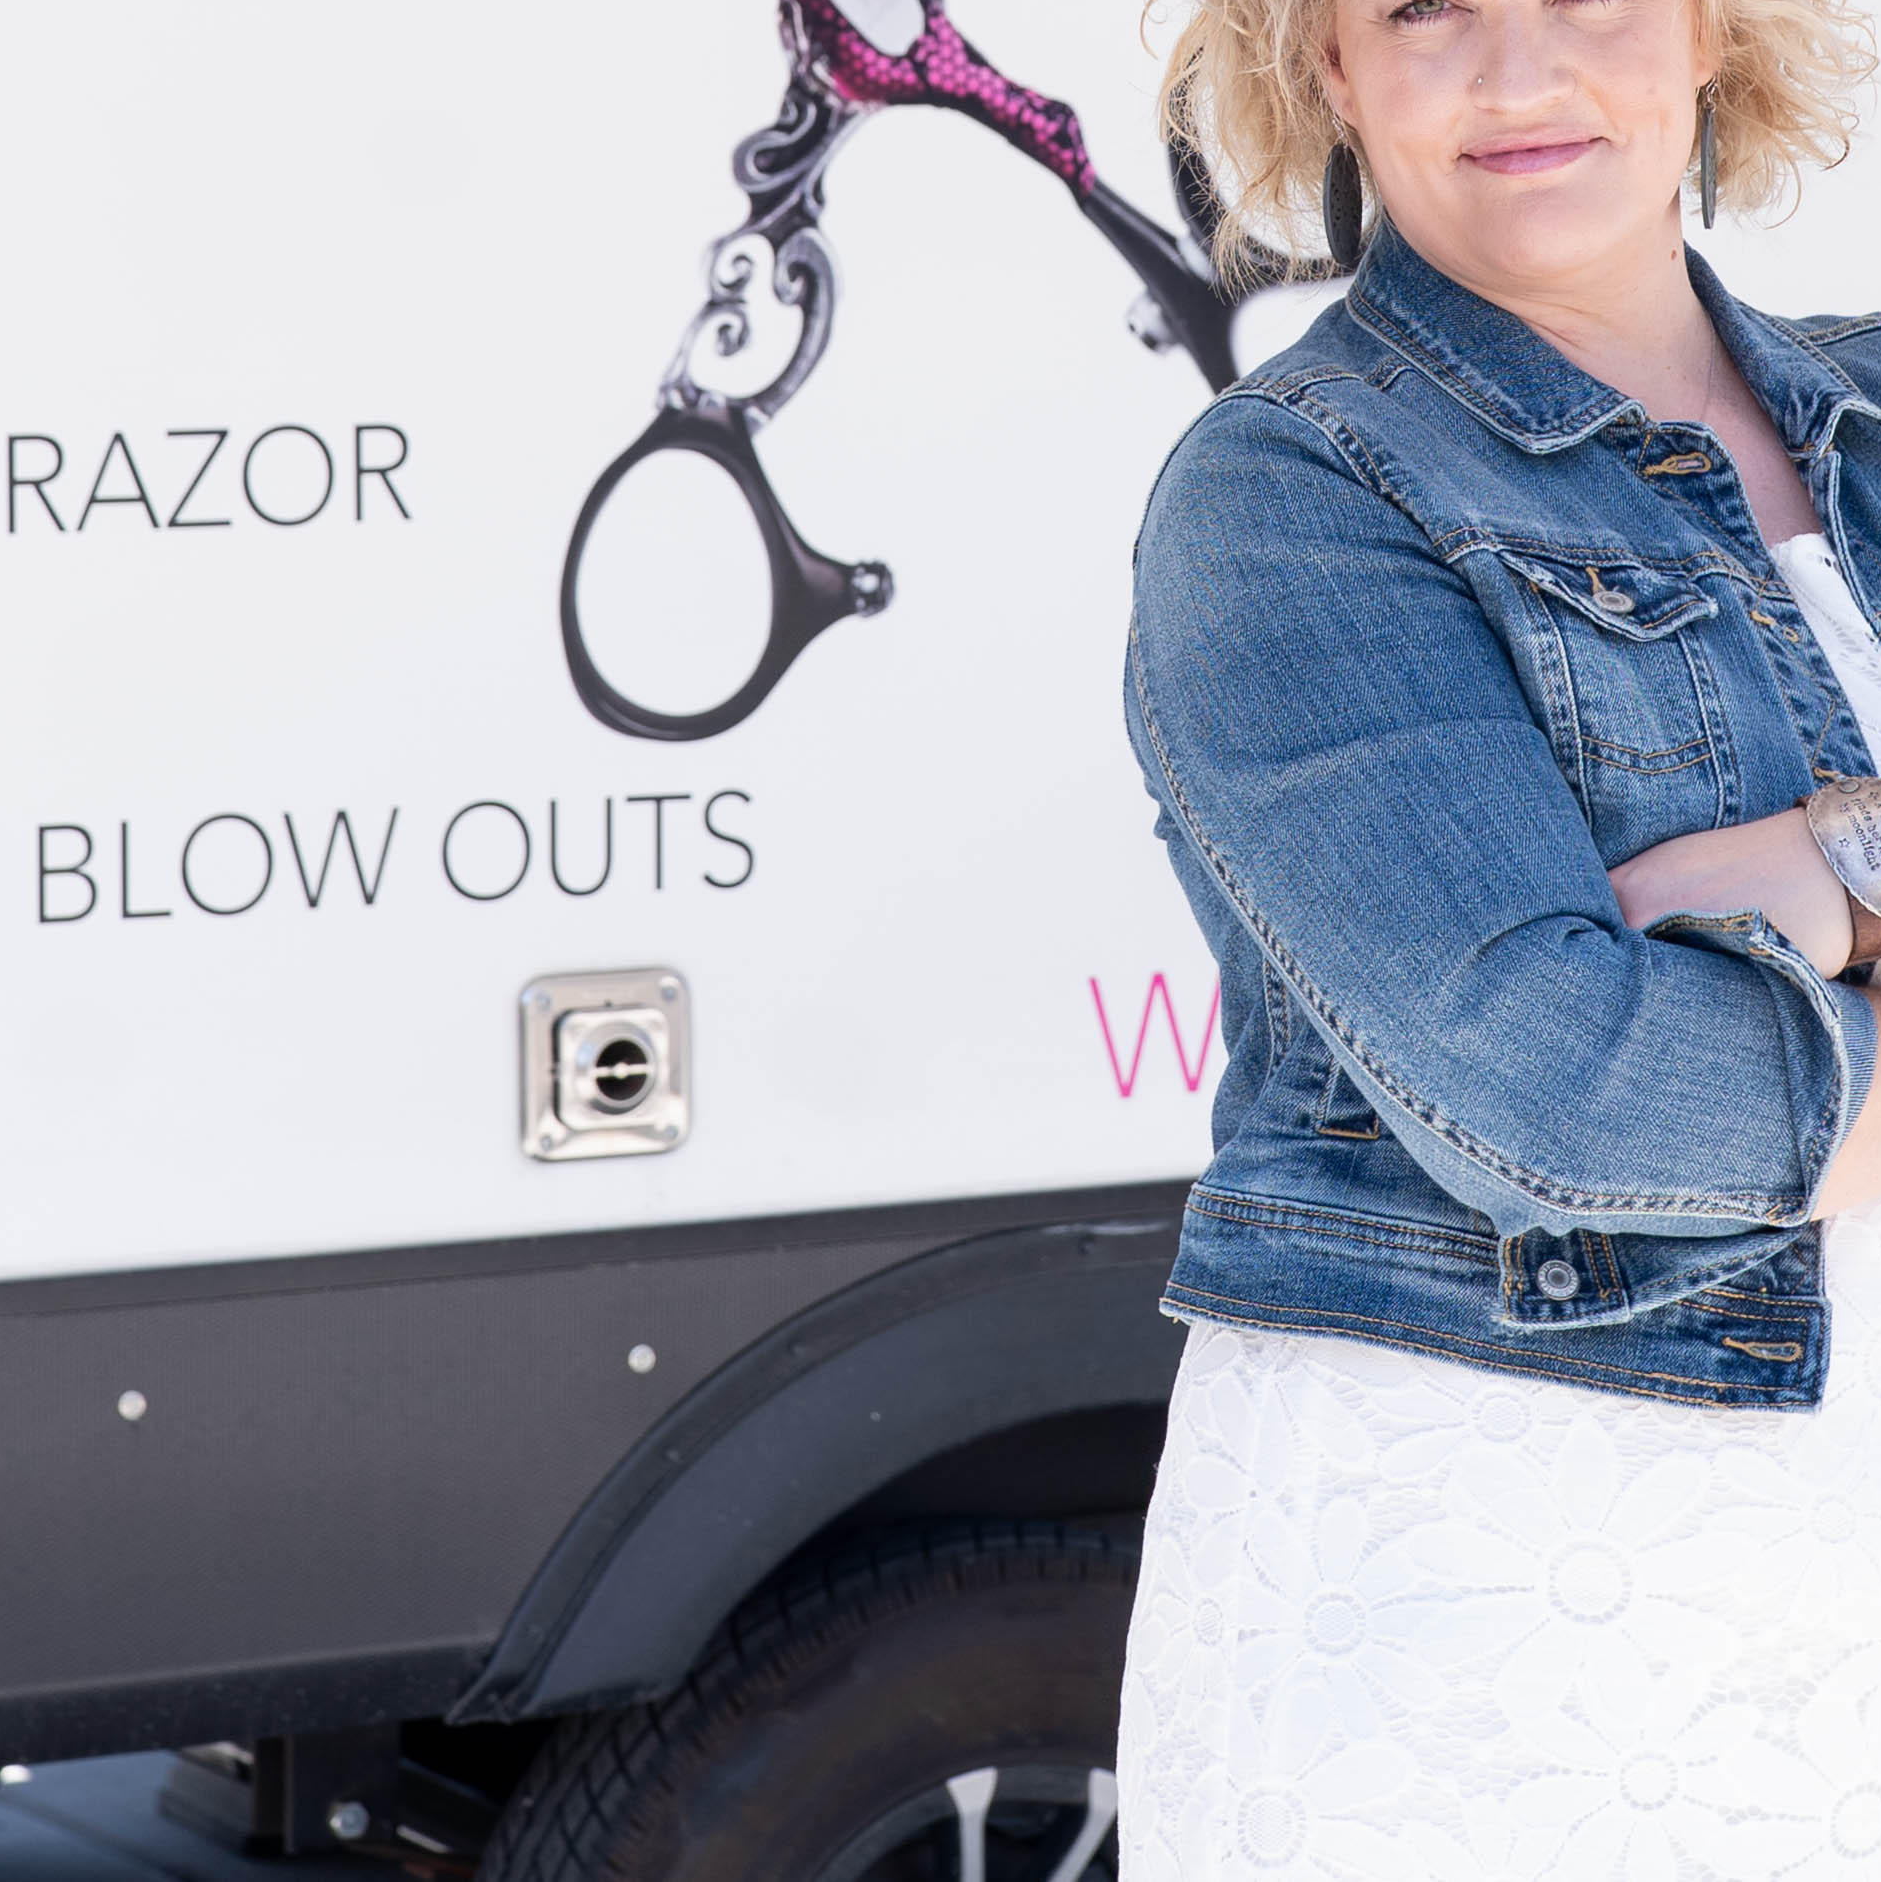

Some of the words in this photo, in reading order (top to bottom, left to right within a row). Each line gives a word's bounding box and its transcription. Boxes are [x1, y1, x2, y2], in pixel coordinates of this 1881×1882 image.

[6, 423, 412, 535] RAZOR
[37, 806, 399, 925] BLOW
[441, 788, 755, 903] OUTS
